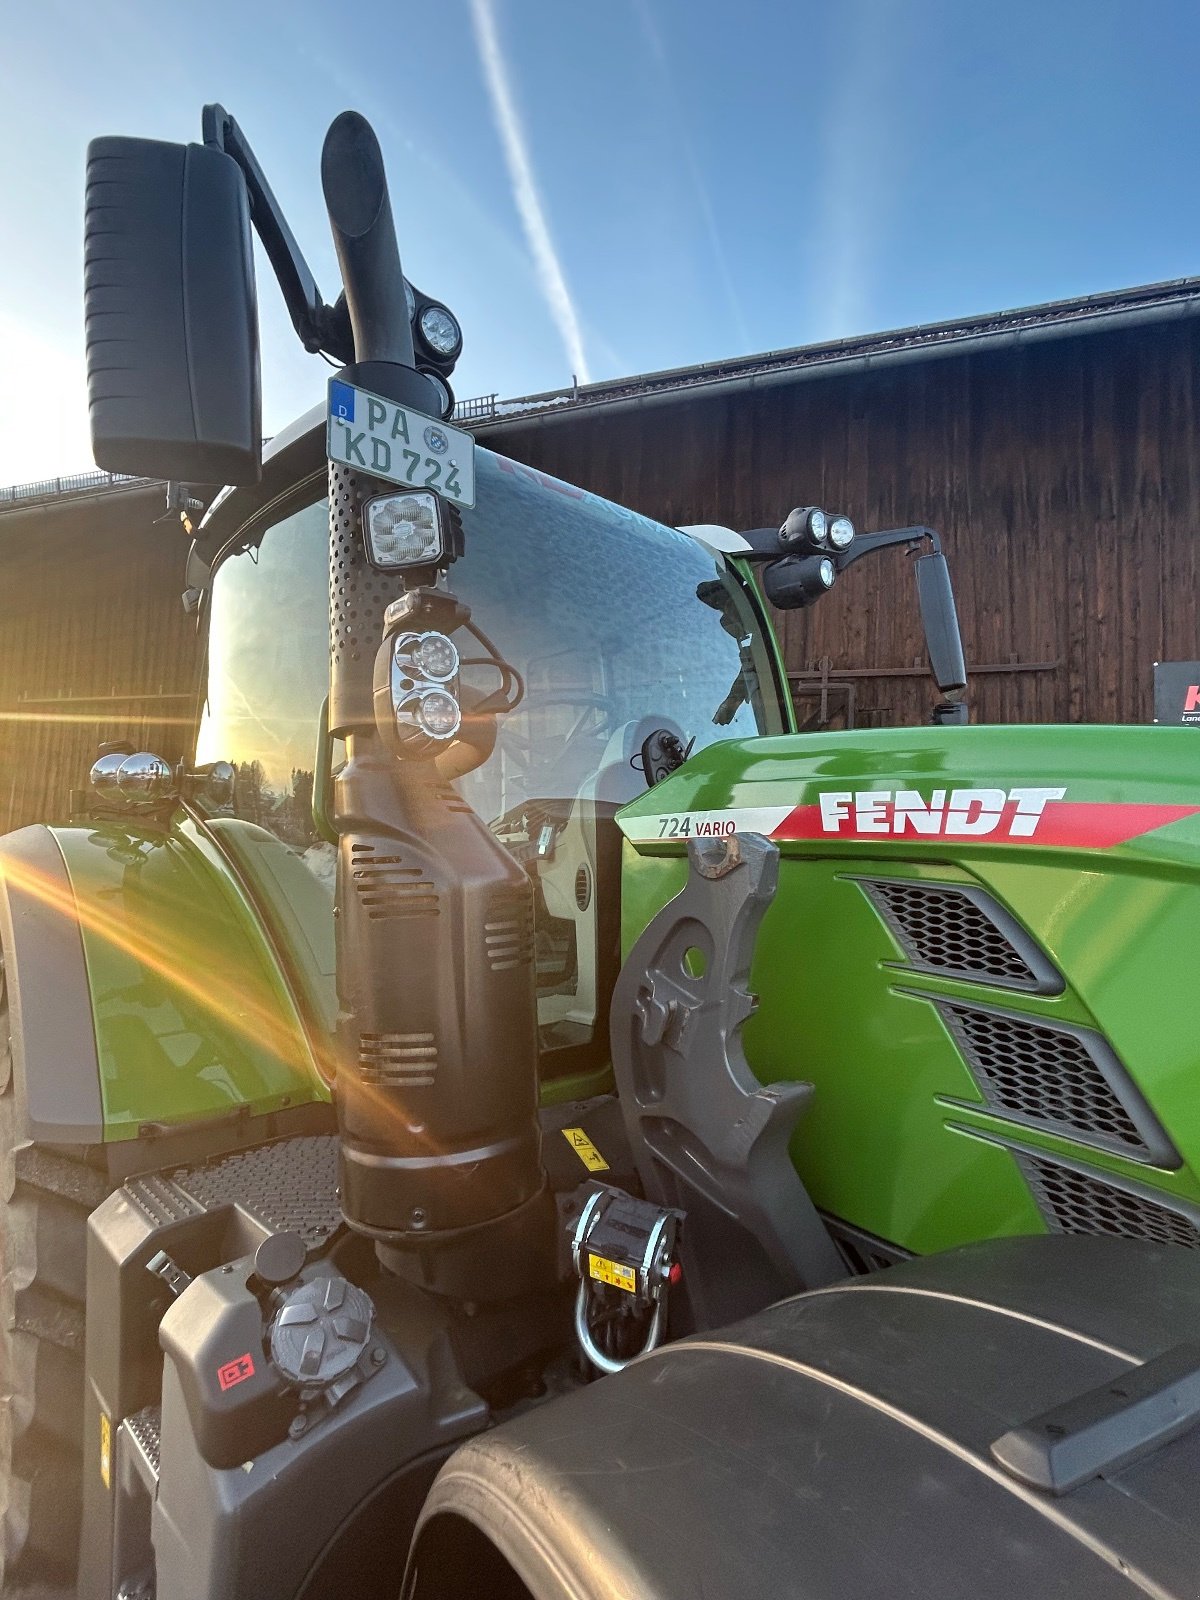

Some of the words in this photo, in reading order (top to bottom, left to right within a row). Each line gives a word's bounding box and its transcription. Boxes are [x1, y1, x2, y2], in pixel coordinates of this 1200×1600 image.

[338, 405, 347, 417] D
[367, 397, 410, 445] PA
[343, 427, 392, 473] KD
[402, 448, 462, 498] 724
[658, 816, 691, 838] 724
[695, 820, 736, 836] VARIO
[818, 787, 1068, 837] FENDT
